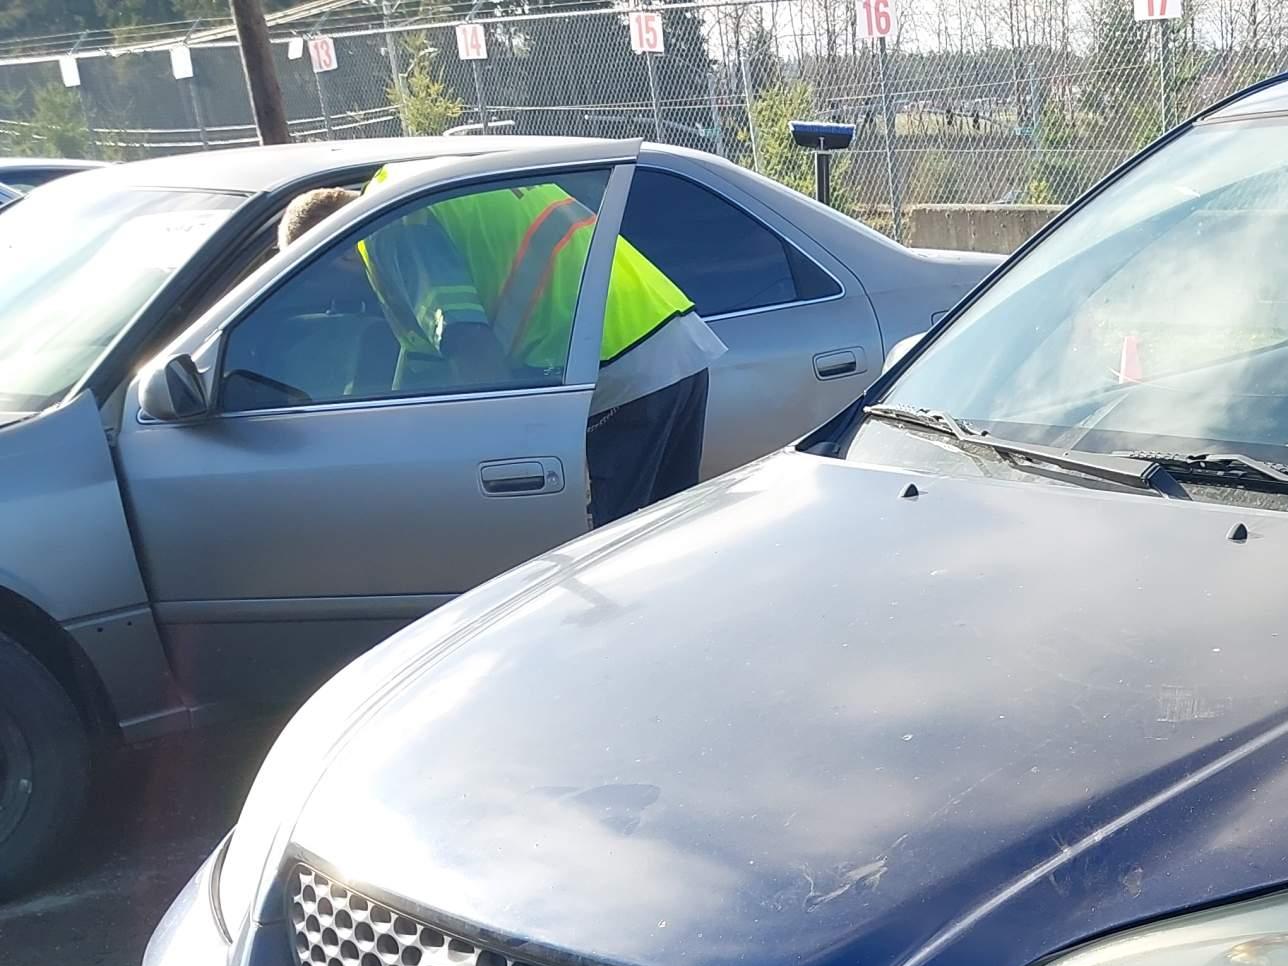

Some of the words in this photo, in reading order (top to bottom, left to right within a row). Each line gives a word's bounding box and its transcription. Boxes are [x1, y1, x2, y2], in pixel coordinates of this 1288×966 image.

[635, 15, 657, 49] 15
[863, 0, 890, 35] 16
[313, 39, 332, 69] 13
[462, 26, 481, 57] 14
